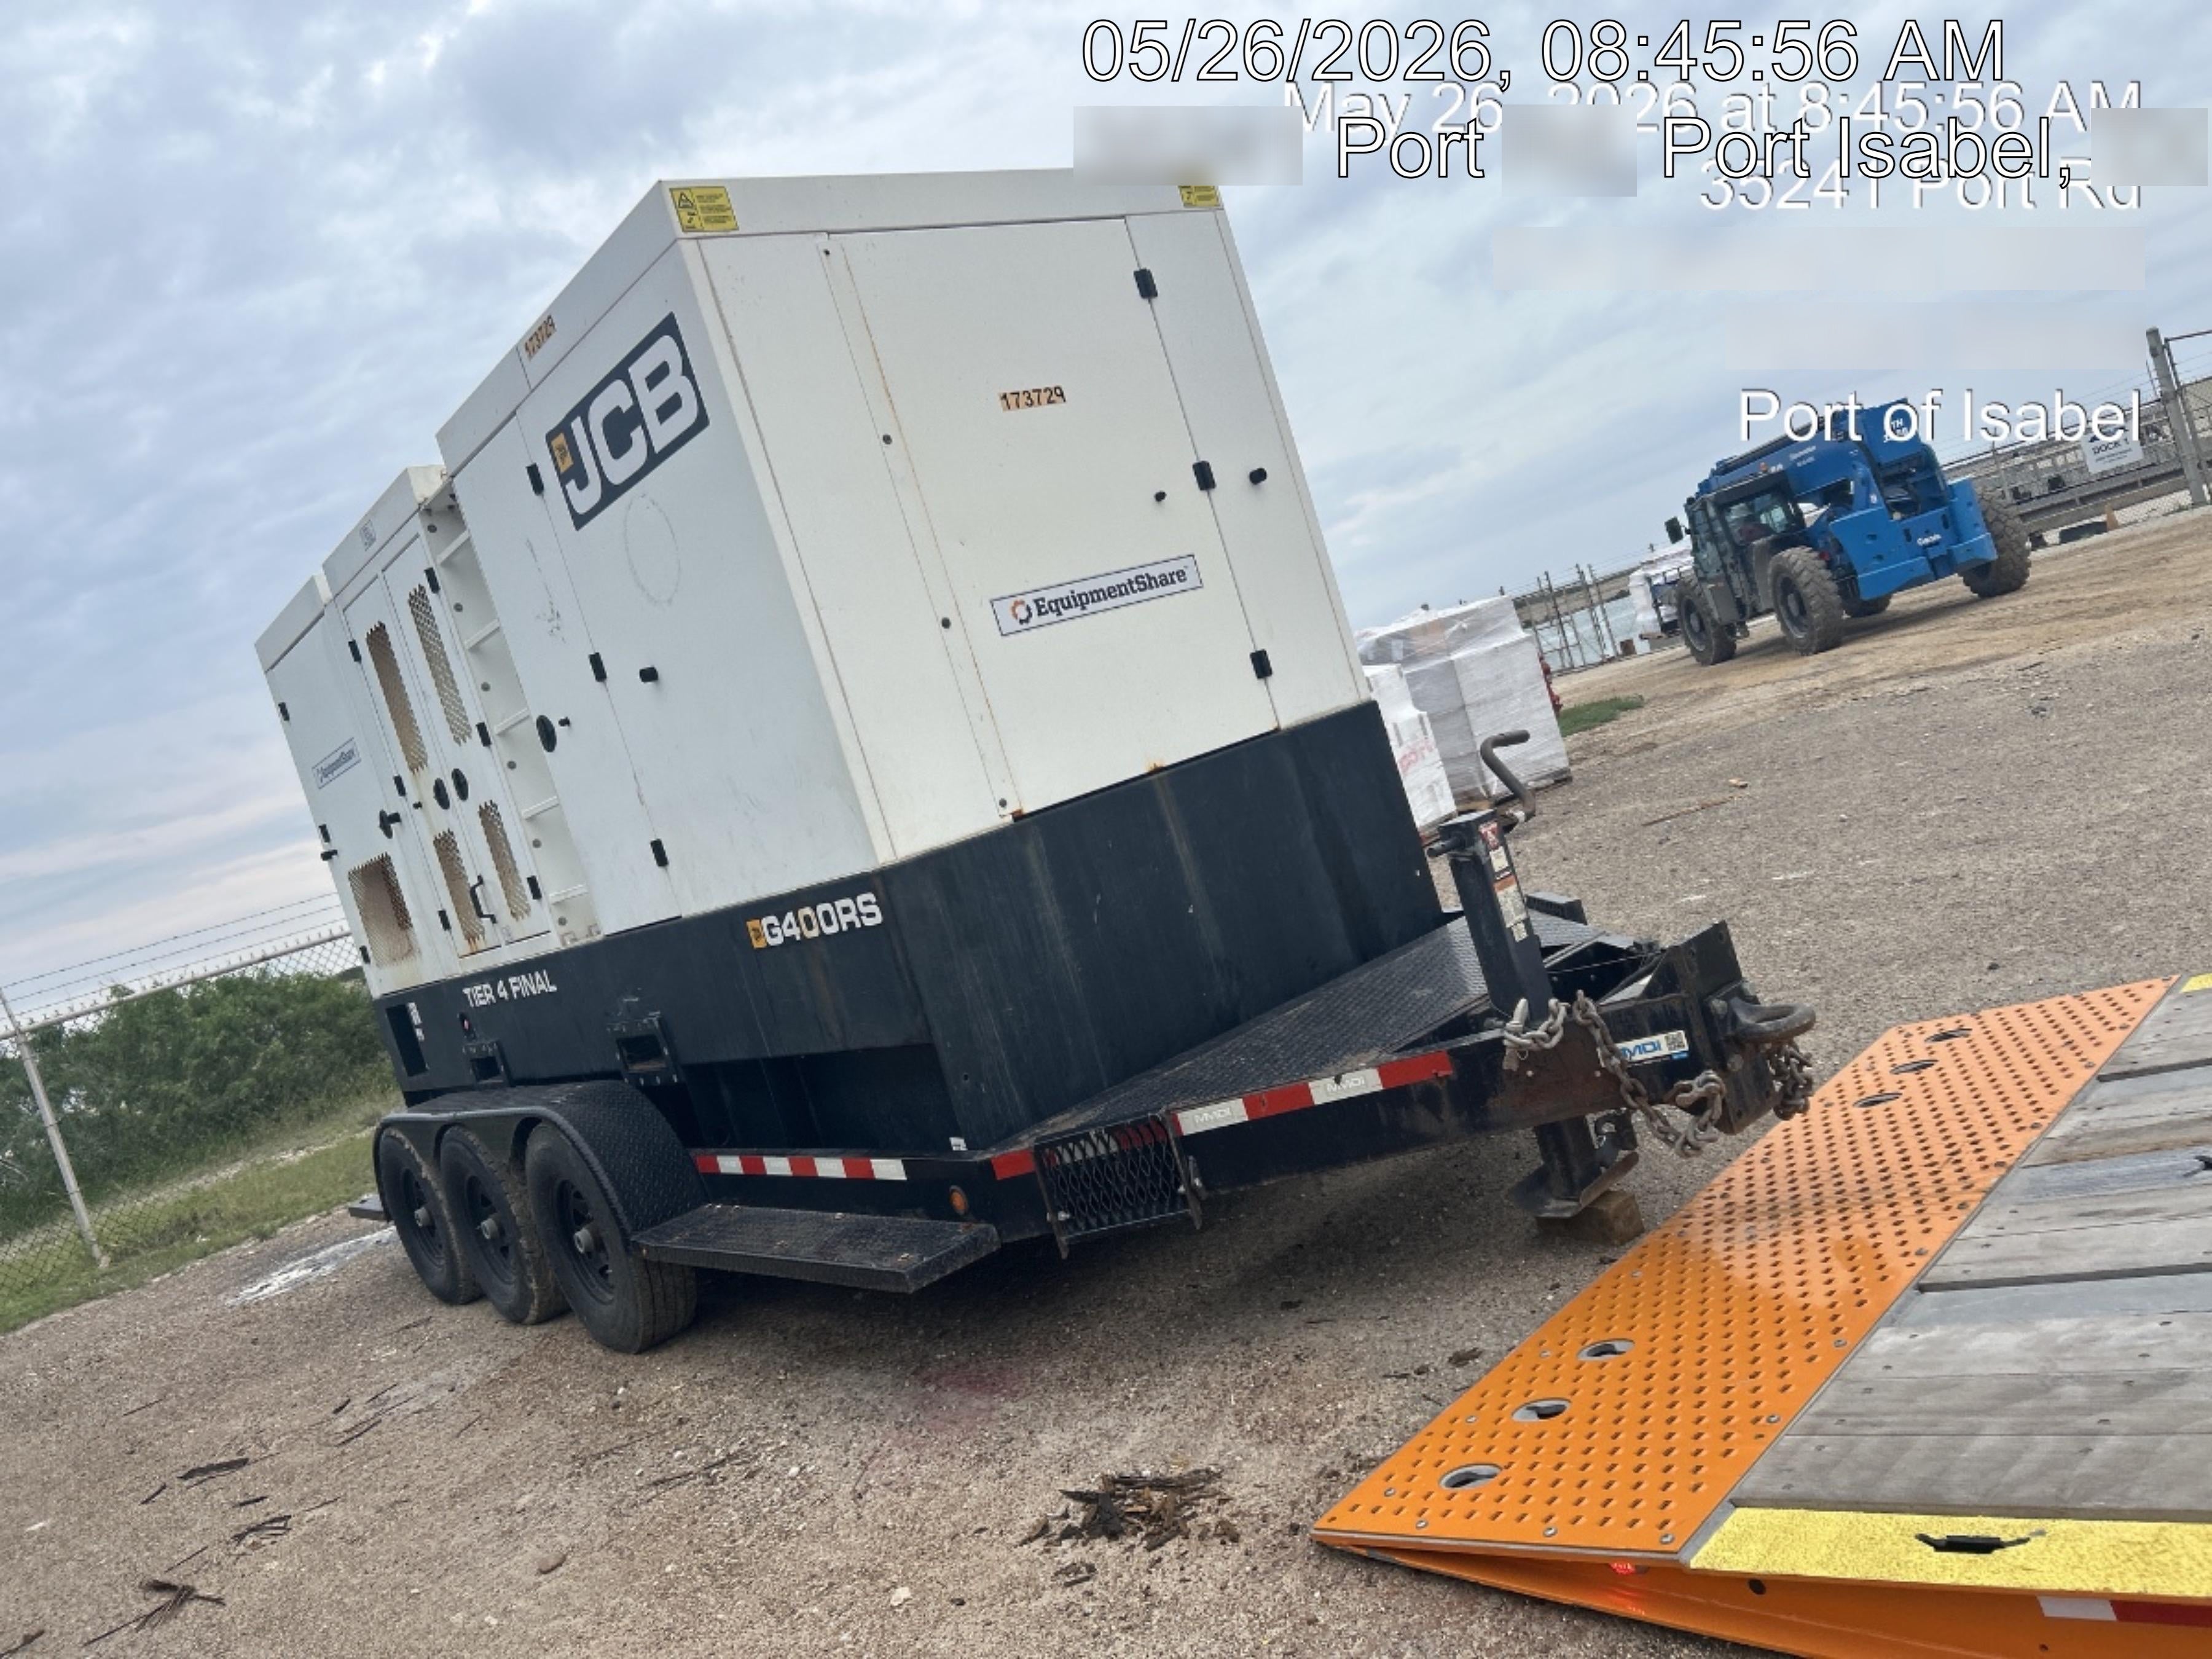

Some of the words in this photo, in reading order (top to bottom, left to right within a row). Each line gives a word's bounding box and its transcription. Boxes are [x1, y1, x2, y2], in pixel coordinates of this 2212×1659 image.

[1000, 385, 1066, 410] 173729
[565, 335, 699, 516] JCB
[1033, 568, 1188, 617] EquipmentShare
[761, 892, 884, 947] G400RS
[462, 982, 496, 1008] TIER
[496, 979, 509, 1002] 4
[508, 969, 557, 1000] FINAL
